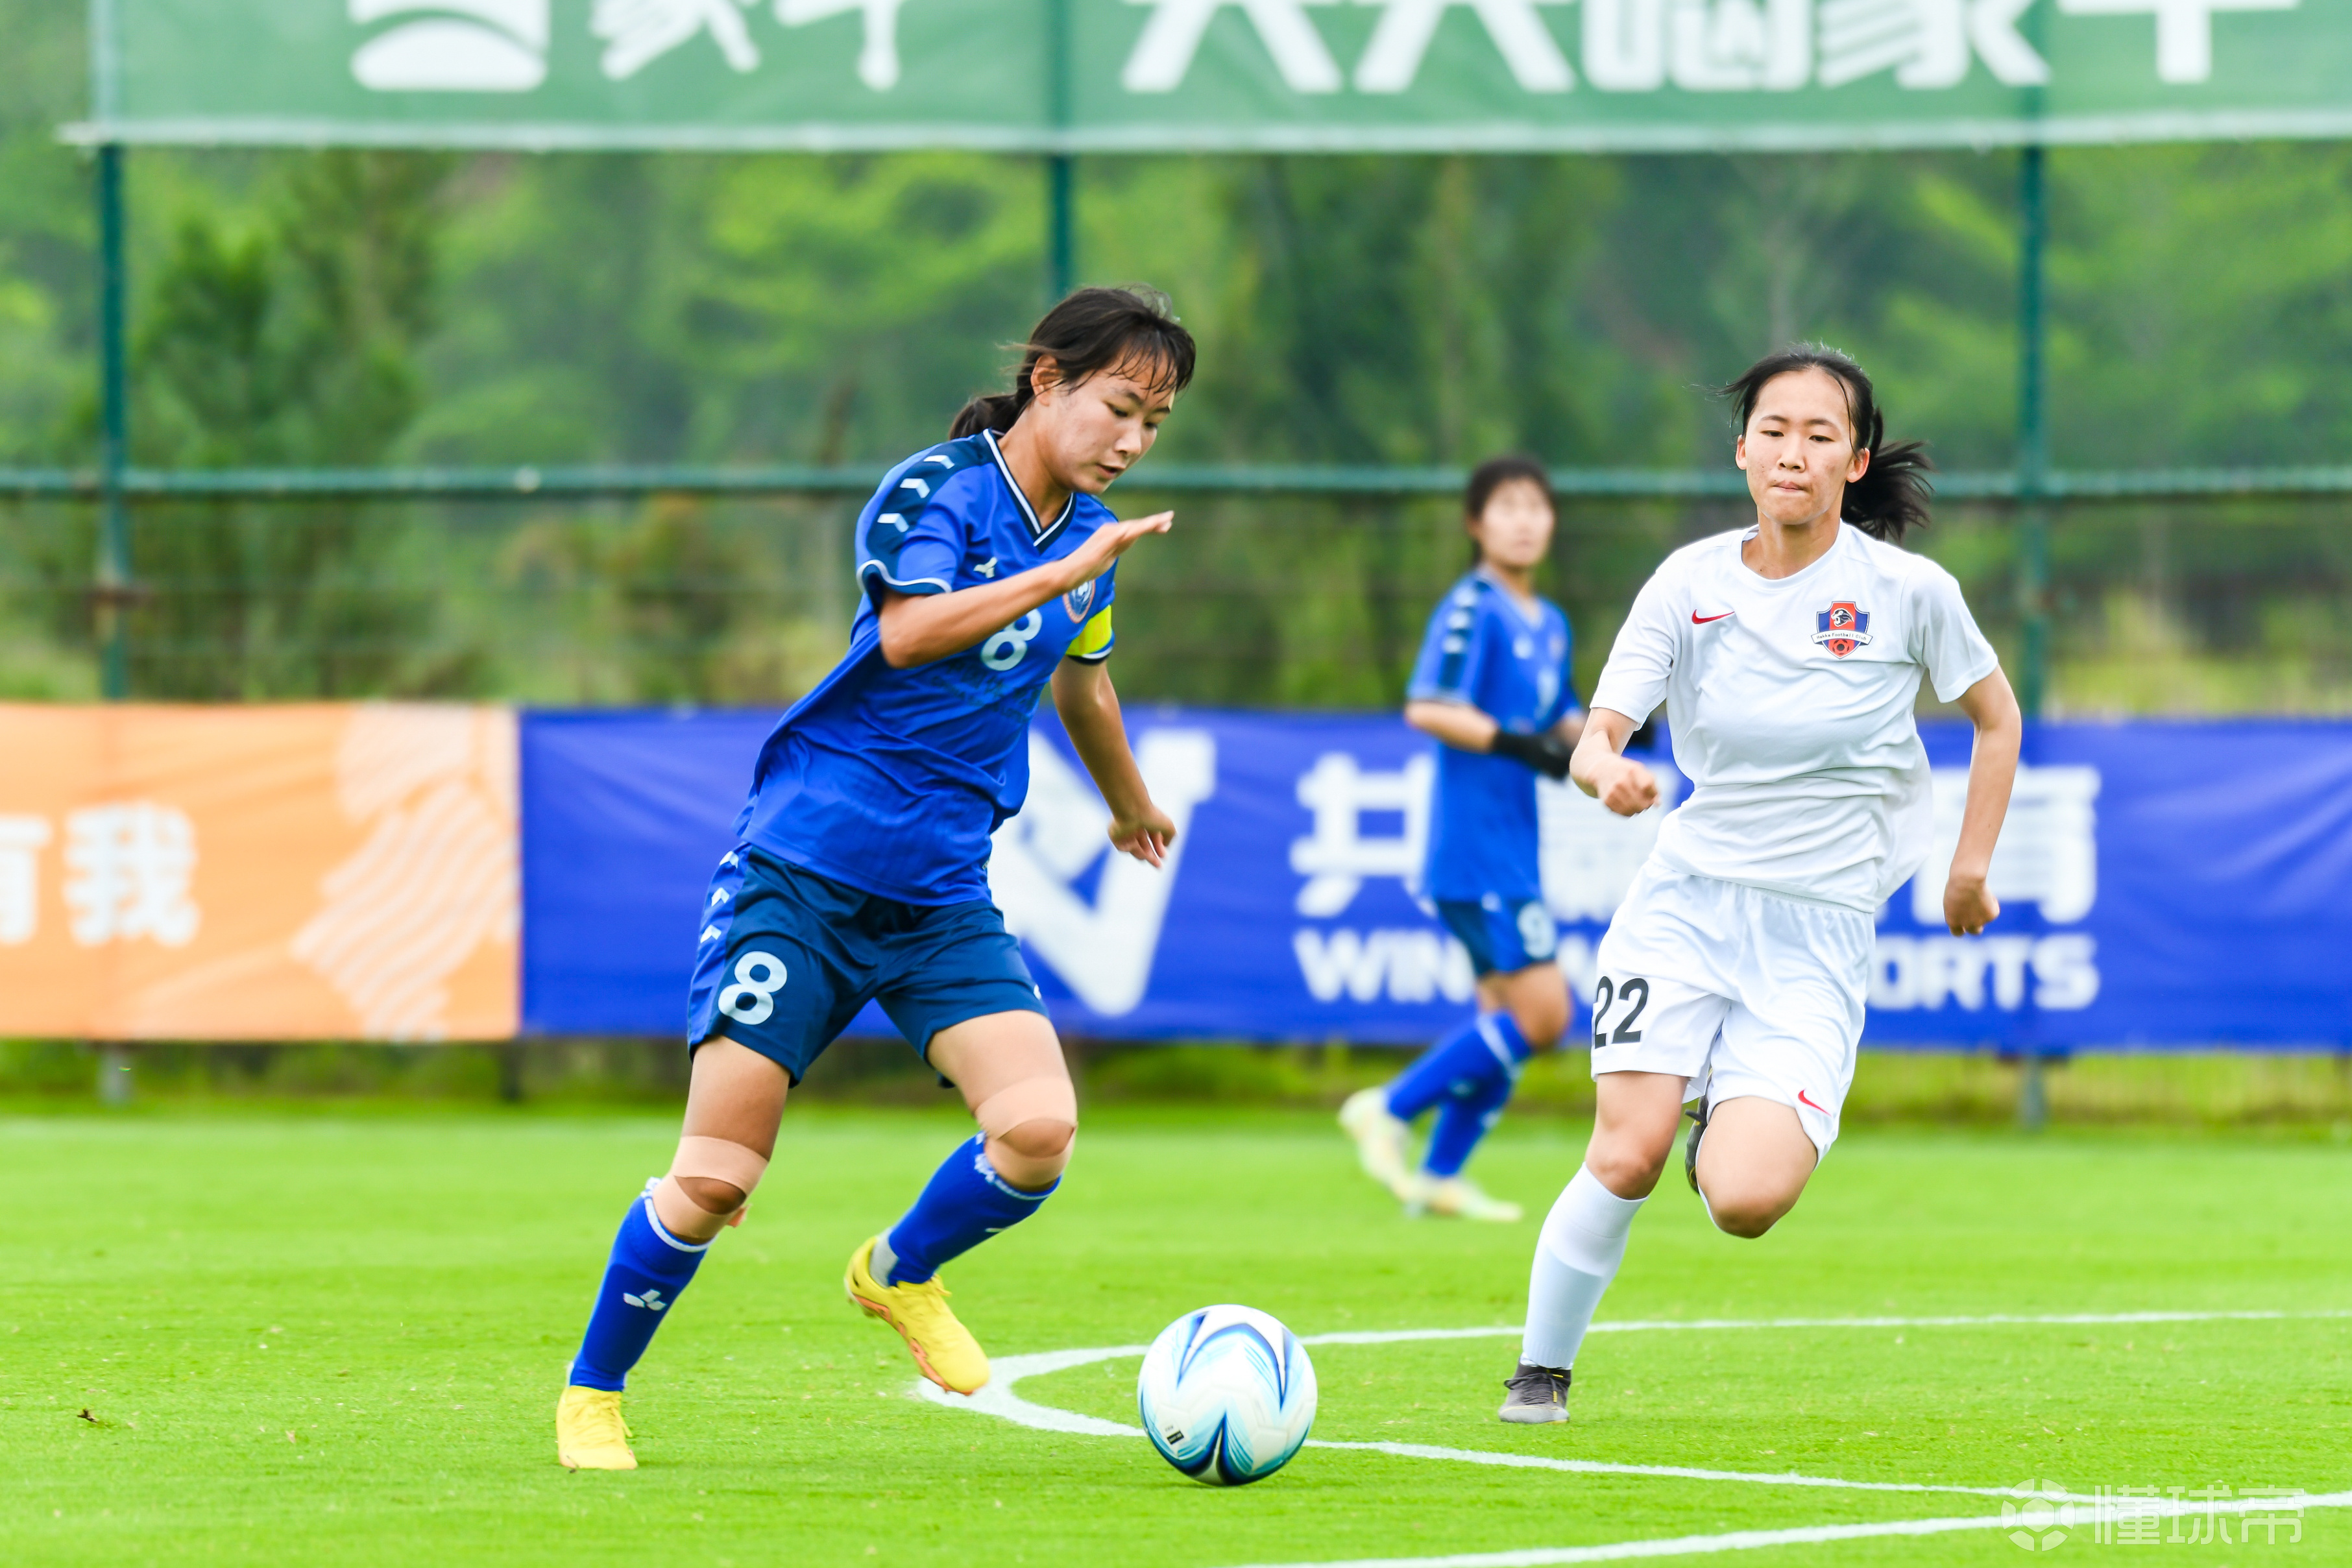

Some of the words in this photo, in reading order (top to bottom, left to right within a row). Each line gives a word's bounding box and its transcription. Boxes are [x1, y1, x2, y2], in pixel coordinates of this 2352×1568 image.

[980, 608, 1043, 671] 8
[718, 951, 787, 1025] 8
[1594, 976, 1649, 1050] 22
